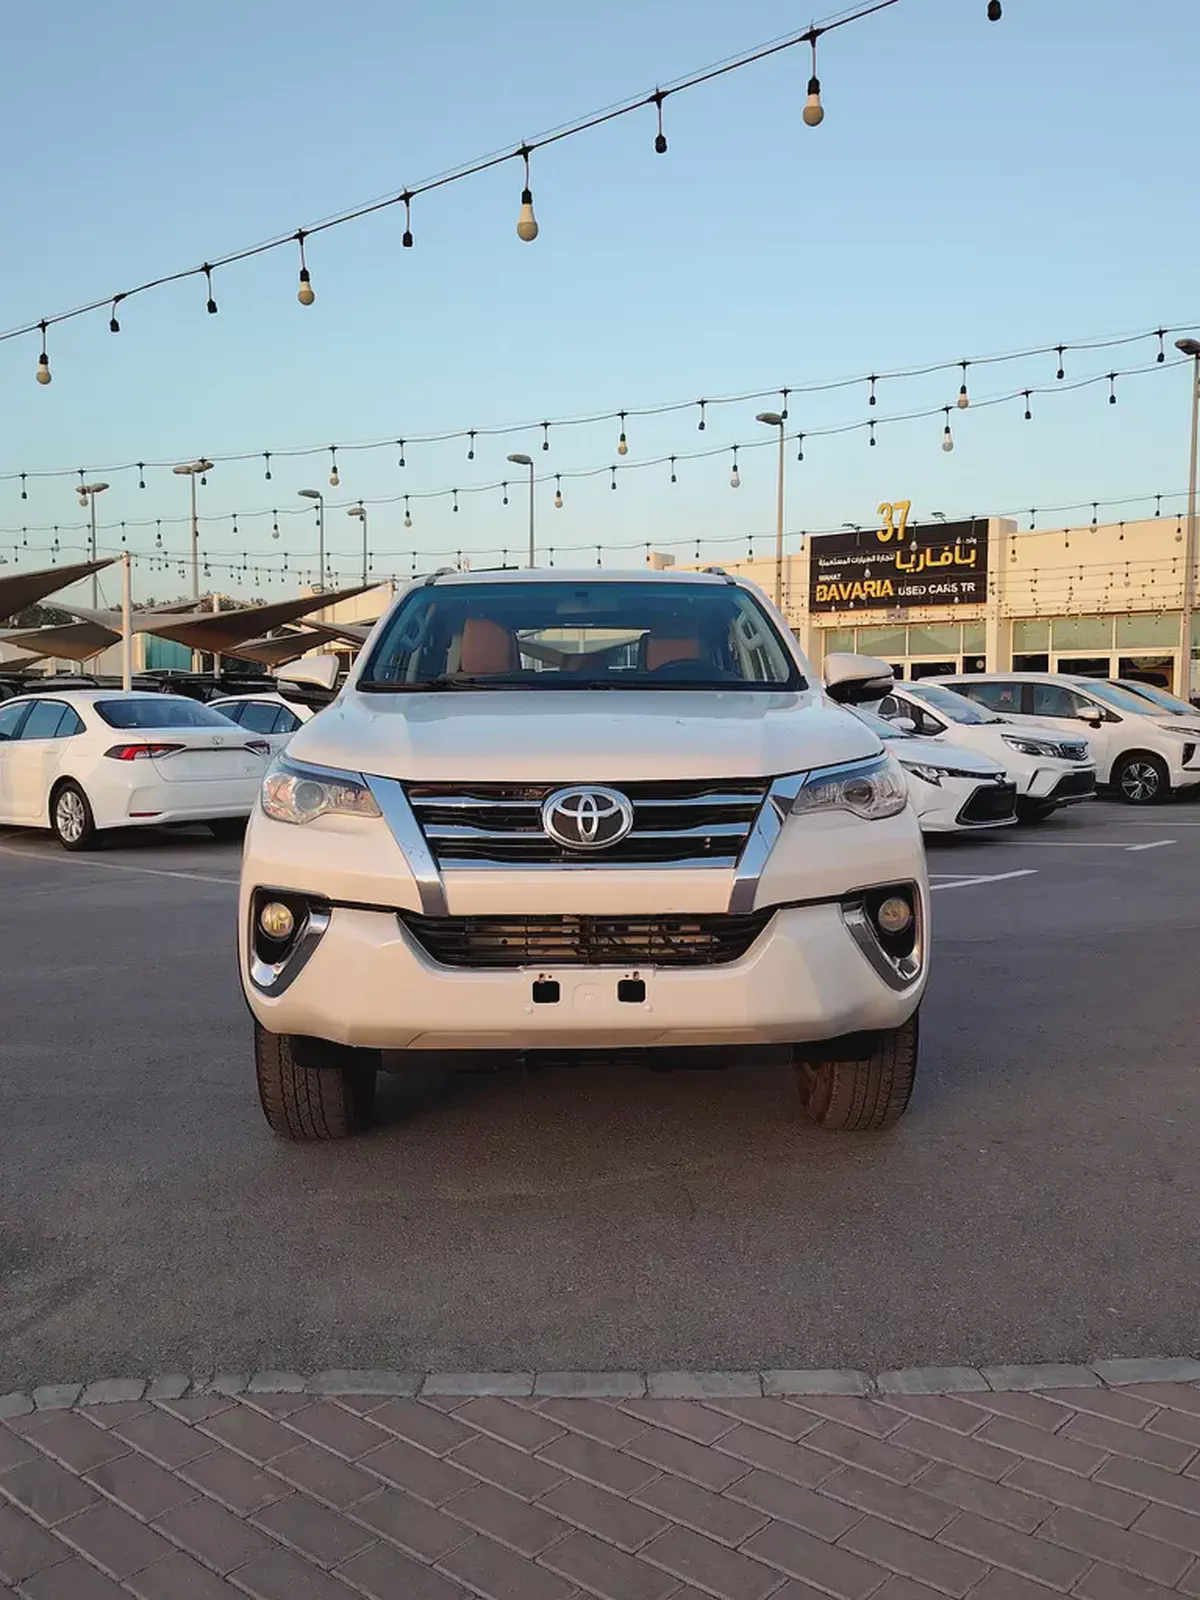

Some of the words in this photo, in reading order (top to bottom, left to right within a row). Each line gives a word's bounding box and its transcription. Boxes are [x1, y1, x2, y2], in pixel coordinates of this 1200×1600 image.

[876, 500, 911, 542] 37
[895, 544, 976, 573] بافاريا
[815, 579, 894, 602] BAVARIA
[898, 586, 927, 596] USED
[928, 583, 958, 594] CARS
[960, 582, 976, 592] TR
